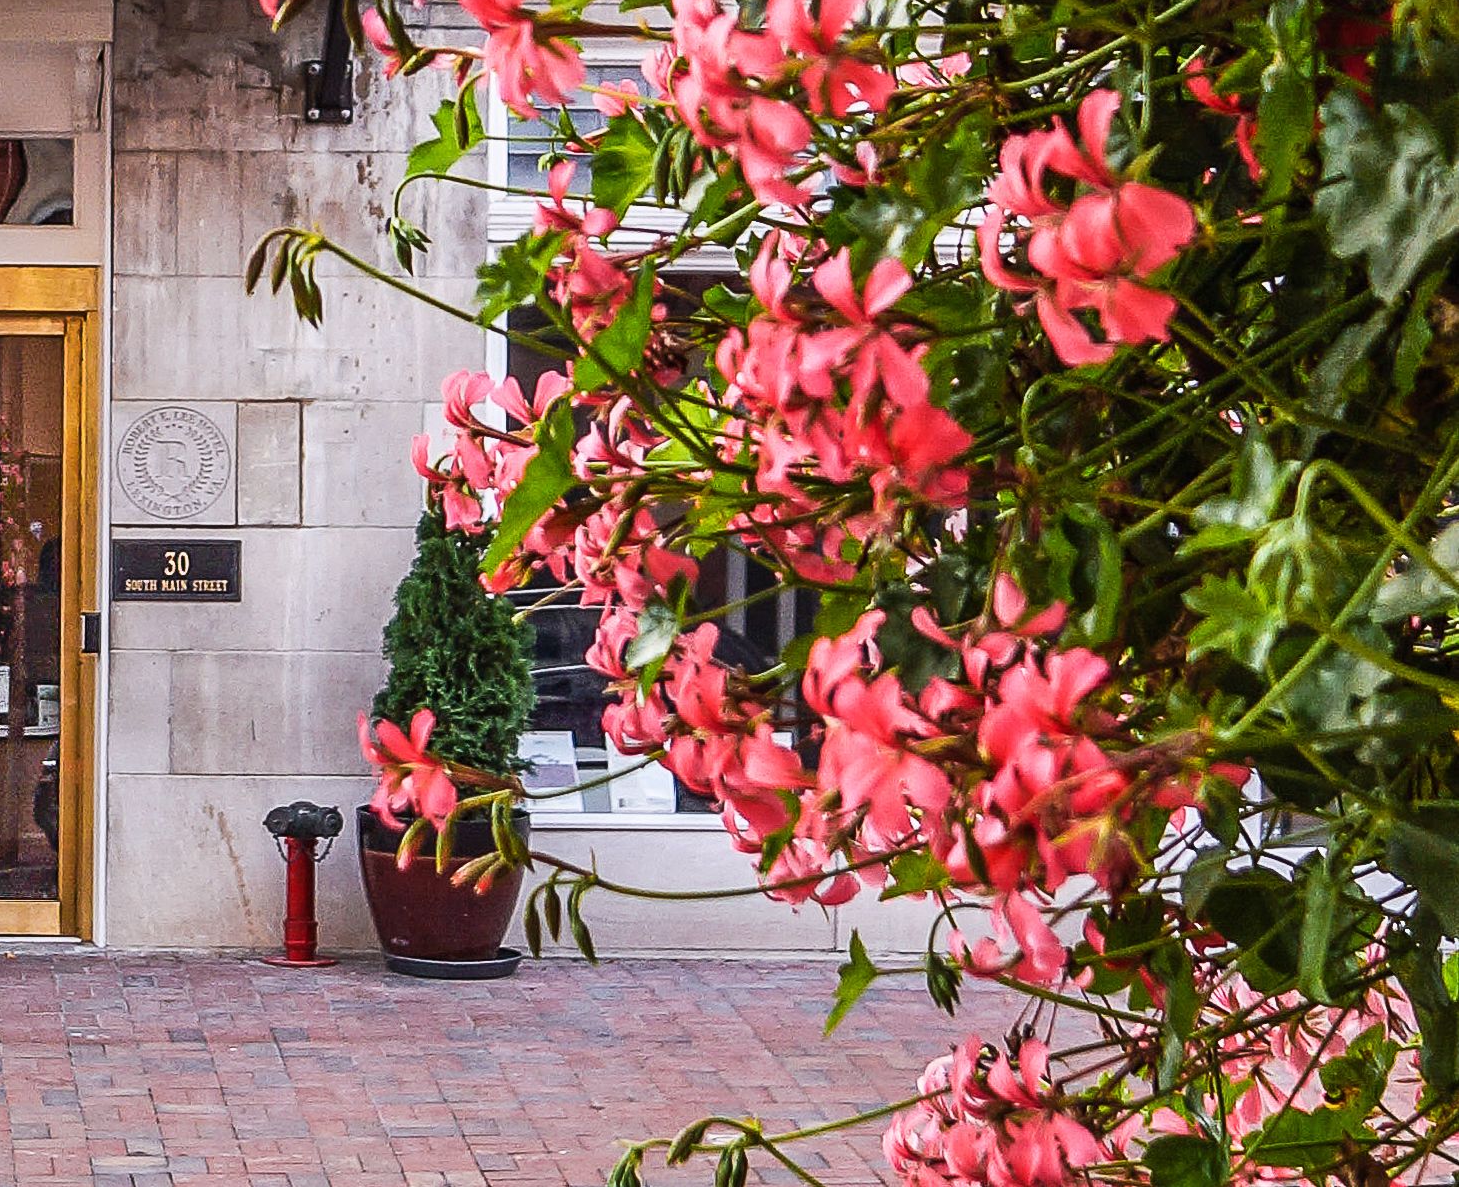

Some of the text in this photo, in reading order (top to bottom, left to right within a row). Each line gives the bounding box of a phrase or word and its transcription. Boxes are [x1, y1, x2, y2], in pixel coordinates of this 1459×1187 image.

[121, 414, 159, 454] ROBERT
[173, 411, 197, 424] LEE
[164, 551, 190, 576] 30
[125, 578, 229, 592] SOUTH MAIN STREET
